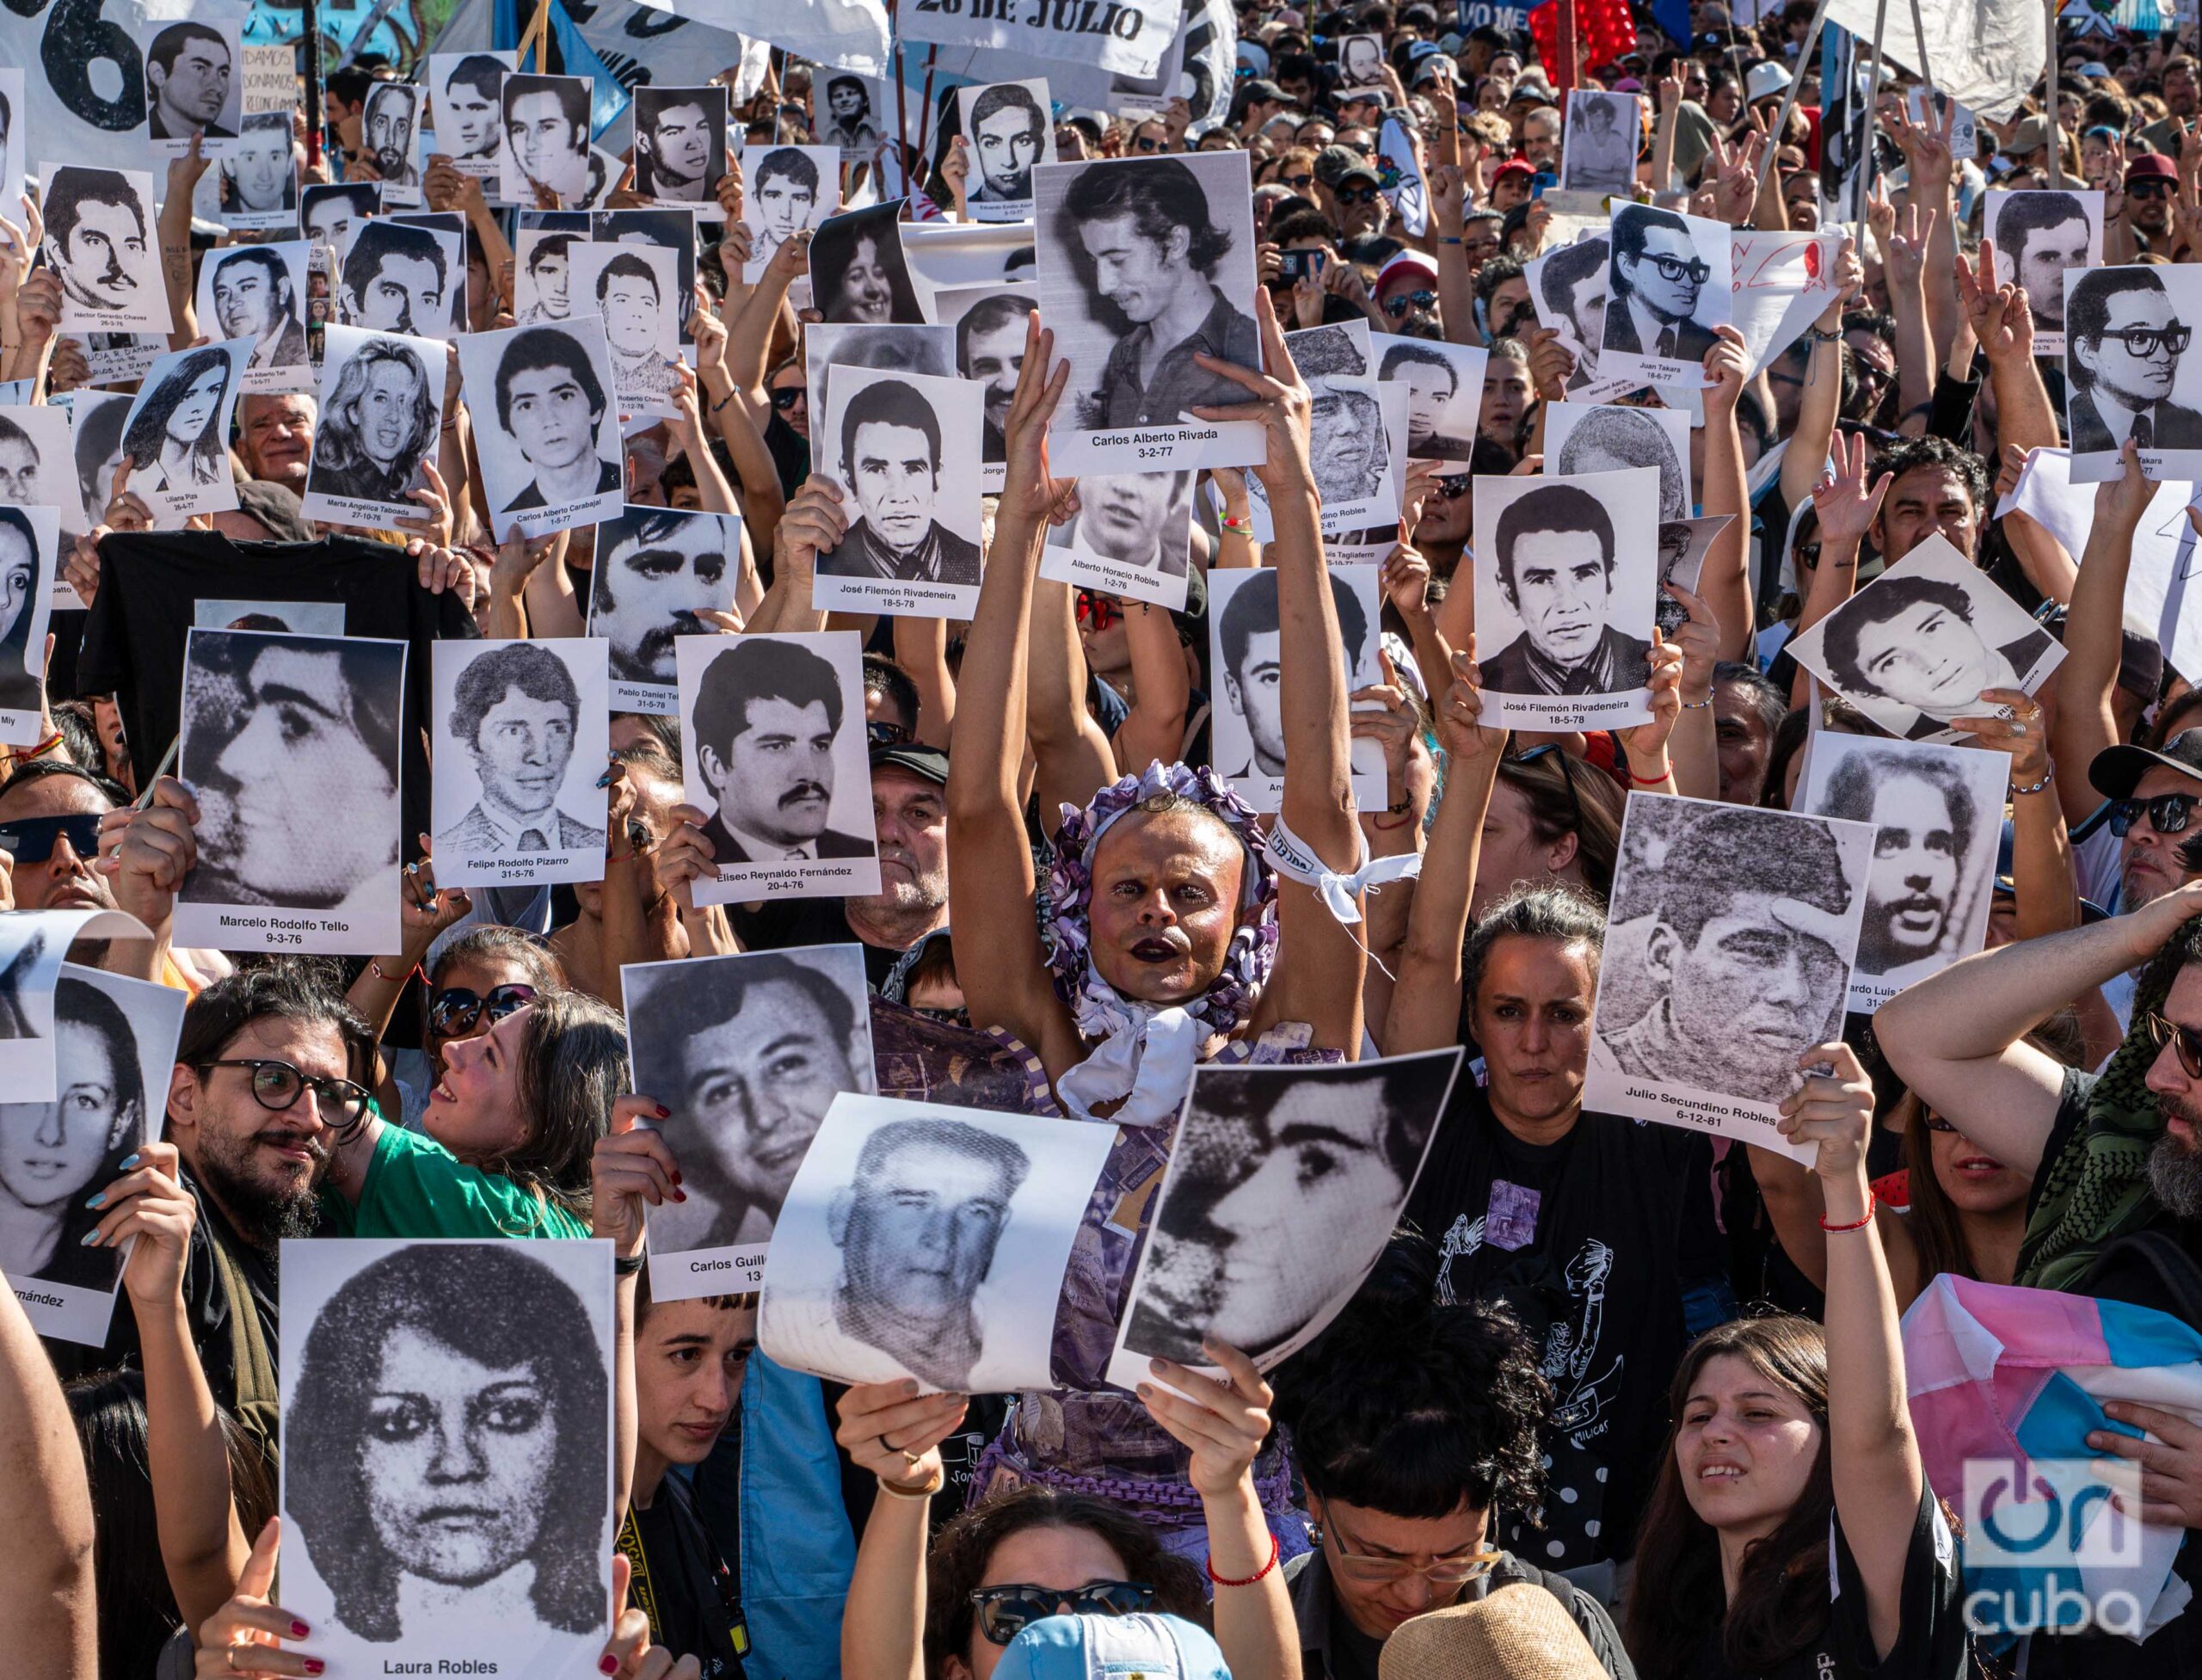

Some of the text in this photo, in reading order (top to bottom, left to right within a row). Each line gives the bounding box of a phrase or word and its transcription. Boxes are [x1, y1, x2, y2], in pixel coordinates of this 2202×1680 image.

[1027, 0, 1143, 40] JULIO
[1639, 361, 1681, 373] Juan Takara
[1589, 385, 1611, 396] Manuel
[1092, 429, 1218, 447] Carlos Alberto Rivada
[1139, 446, 1173, 458] 3-2-77
[983, 467, 1006, 477] Jorge
[327, 499, 409, 516] Marta Angélica Taboada
[516, 499, 602, 523] Carlos Alberto Carabajal
[1339, 507, 1367, 517] Robles
[352, 512, 382, 521] 27-10-76
[550, 515, 571, 526] 1-5-77
[1338, 551, 1375, 561] Tagliaferro
[1071, 559, 1160, 588] Alberto Horacio Robles
[1104, 577, 1128, 590] 1-2-76
[840, 584, 956, 600] José Filemón Rivadeneira
[882, 599, 914, 608] 18-5-78
[618, 687, 640, 697] Pablo
[642, 690, 665, 699] Daniel
[637, 699, 666, 709] 31-5-78
[1503, 699, 1629, 712] José Filemón Rivadeneira
[1548, 715, 1584, 724] 18-5-78
[467, 856, 569, 870] Felipe Rodolfo Pizarro
[501, 870, 534, 879] 31-5-76
[716, 865, 852, 883] Eliseo Reynaldo Fernández
[767, 880, 804, 891] 20-4-76
[219, 915, 349, 932] Marcelo Rodolfo Tello
[266, 932, 303, 945] 9-3-76
[1874, 987, 1897, 997] Luis
[1626, 1086, 1776, 1127] Julio Secundino Robles
[1676, 1110, 1721, 1127] 6-12-81
[690, 1259, 732, 1272] Carlos
[1575, 1418, 1609, 1442] MILICOS
[384, 1659, 499, 1675] Laura Robles
